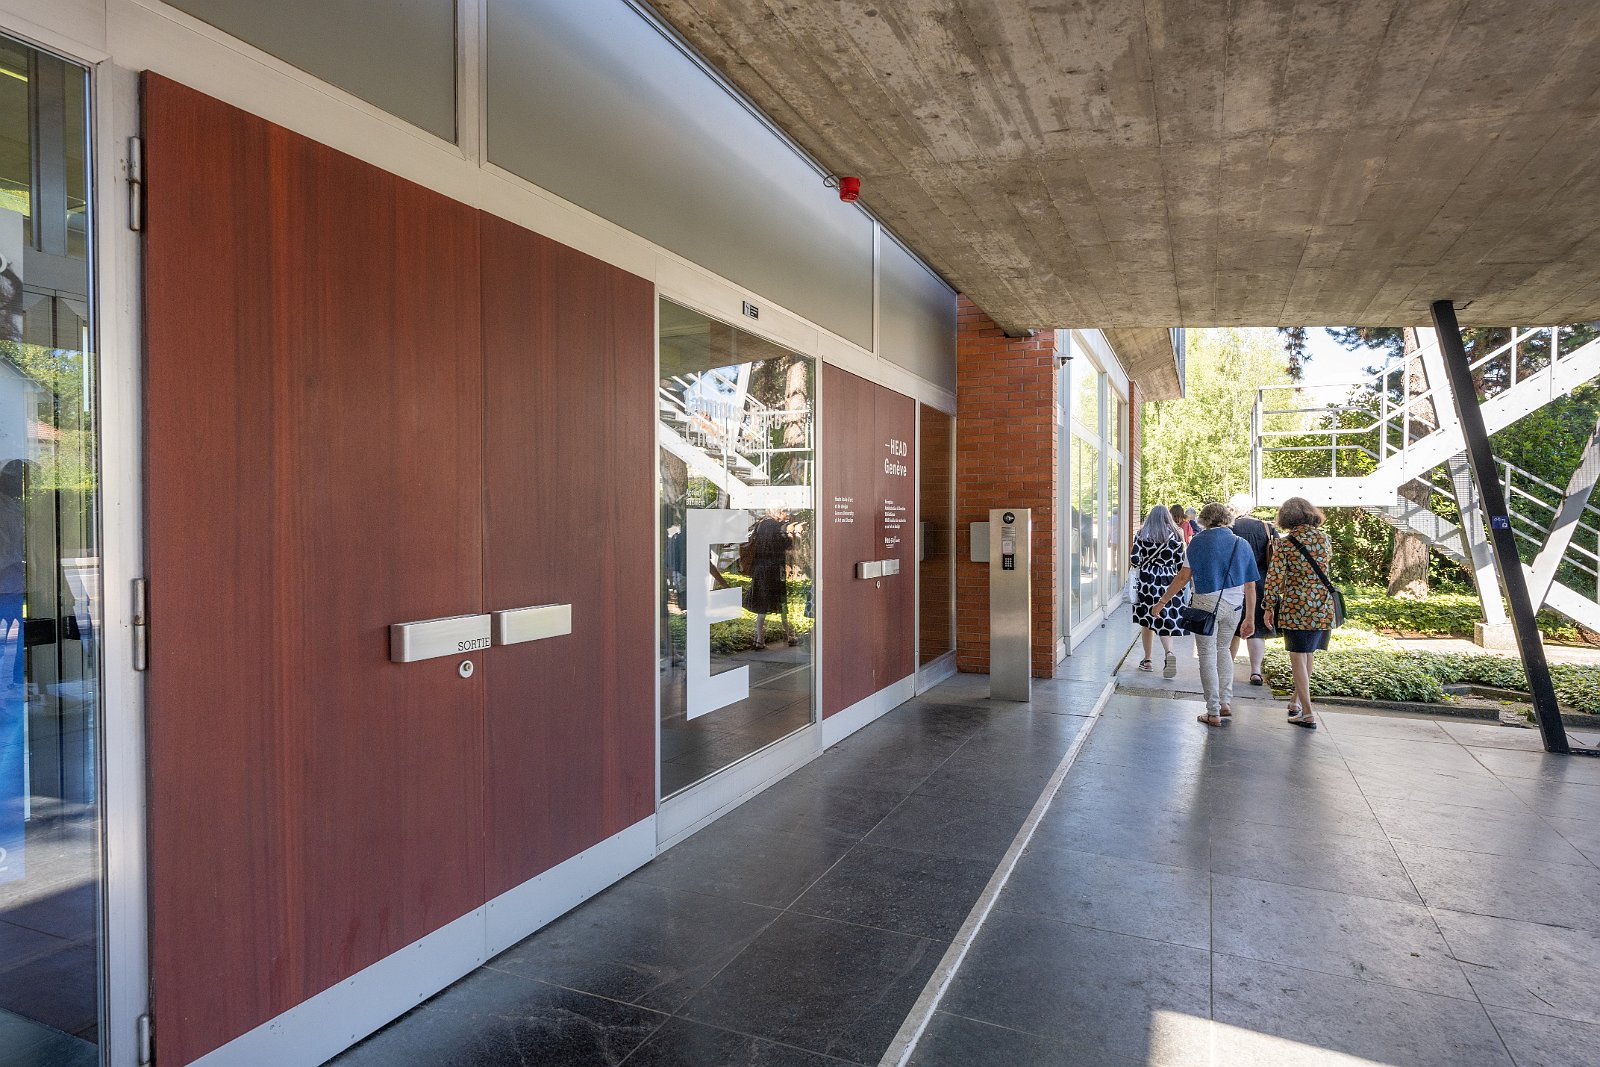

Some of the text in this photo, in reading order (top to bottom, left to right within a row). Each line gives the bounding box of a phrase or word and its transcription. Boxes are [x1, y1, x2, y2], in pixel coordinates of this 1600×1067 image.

[884, 457, 907, 477] Genève
[686, 509, 749, 721] E
[457, 637, 490, 651] SORTIE
